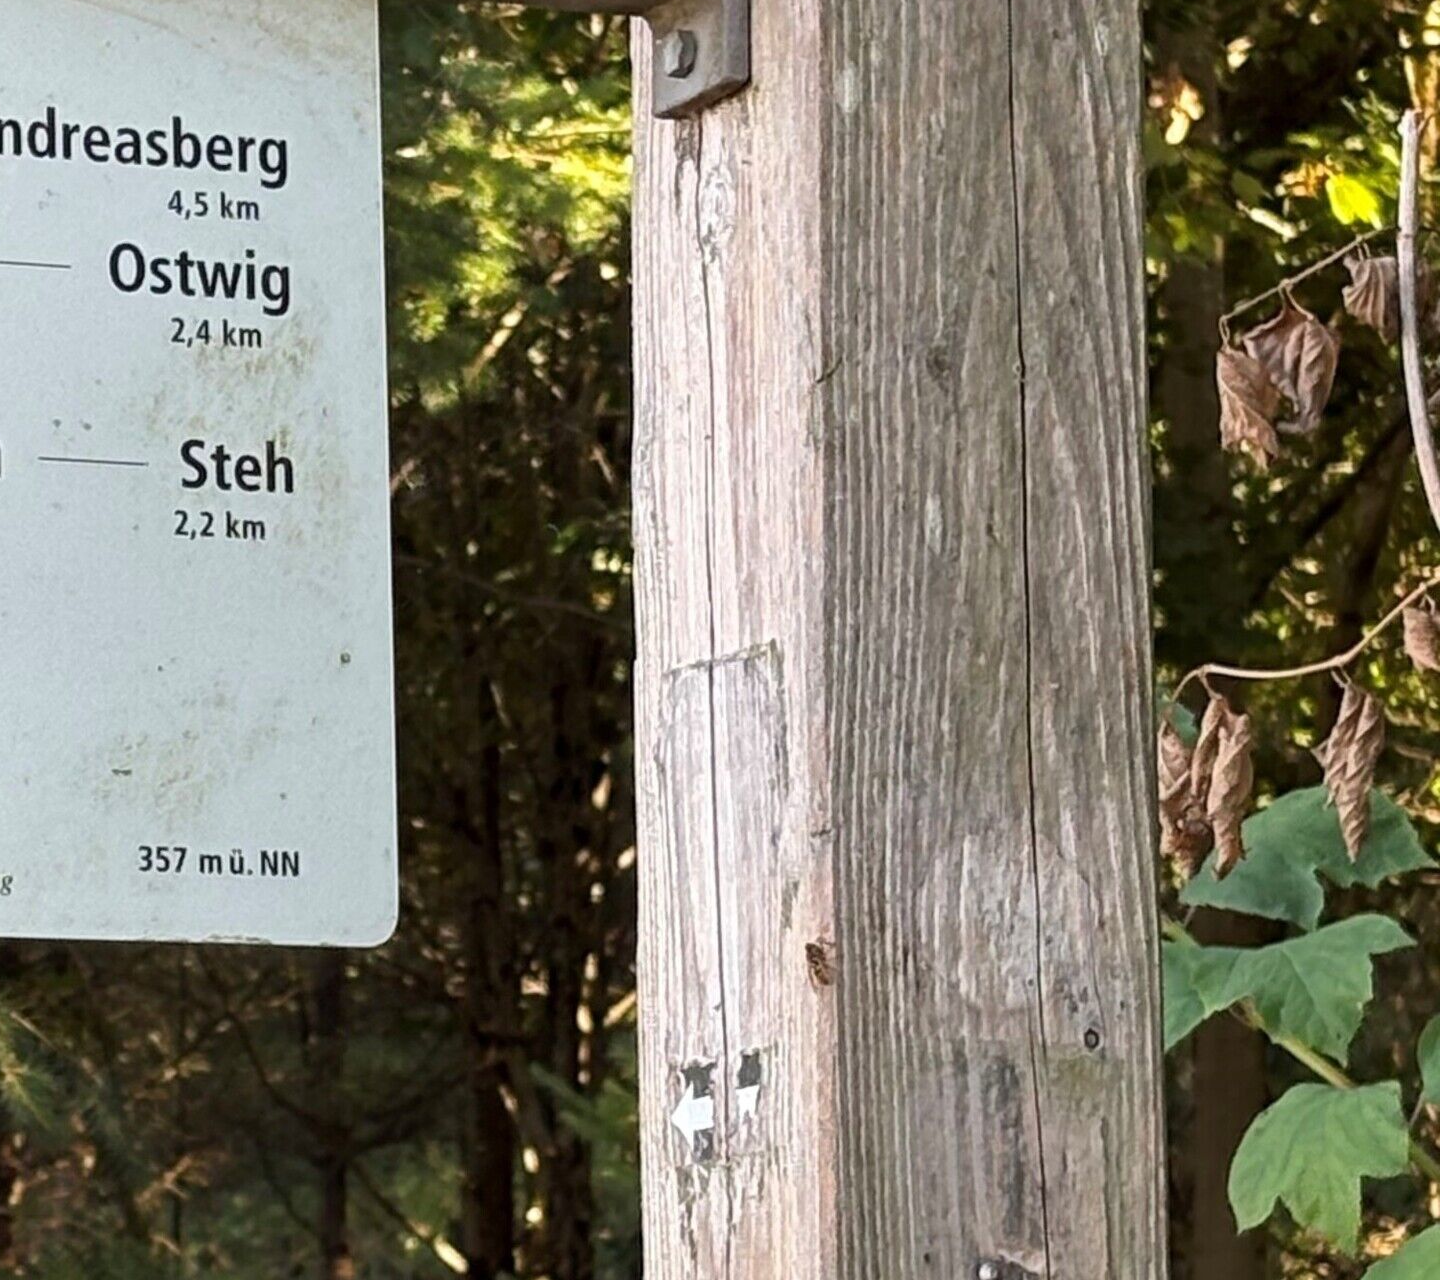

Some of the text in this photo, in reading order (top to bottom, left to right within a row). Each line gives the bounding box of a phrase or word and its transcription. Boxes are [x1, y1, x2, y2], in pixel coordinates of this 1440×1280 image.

[167, 190, 260, 221] 4,5 km
[109, 242, 291, 317] Ostwig
[170, 318, 262, 349] 2,4 km
[180, 439, 294, 494] Steh
[174, 509, 266, 541] 2,2 km
[138, 845, 188, 873] 357
